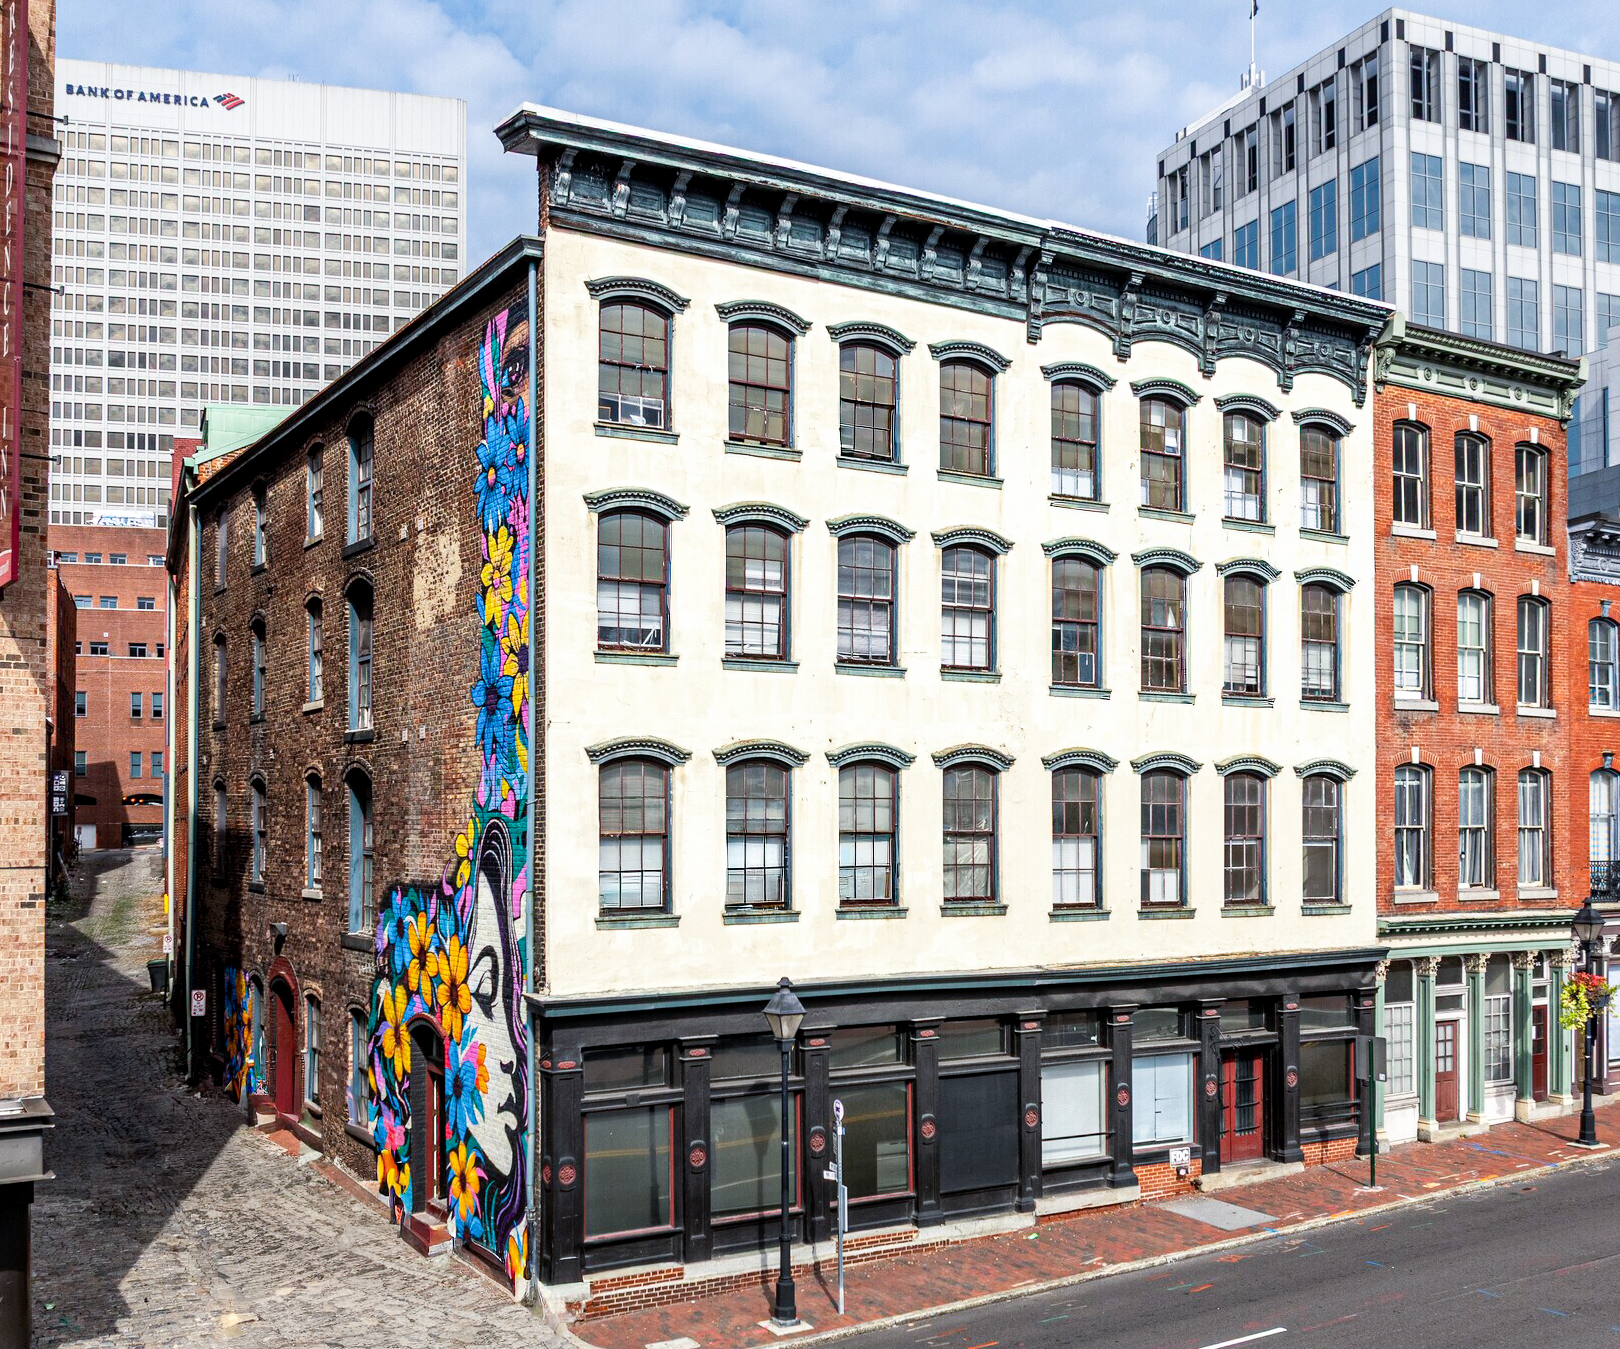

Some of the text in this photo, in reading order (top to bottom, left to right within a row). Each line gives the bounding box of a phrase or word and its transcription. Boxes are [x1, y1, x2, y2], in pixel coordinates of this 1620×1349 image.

[66, 83, 210, 108] BANK OF AMERICA
[3, 1, 16, 358] RESIDENCE
[0, 406, 8, 521] INN
[1171, 1149, 1189, 1162] FDC
